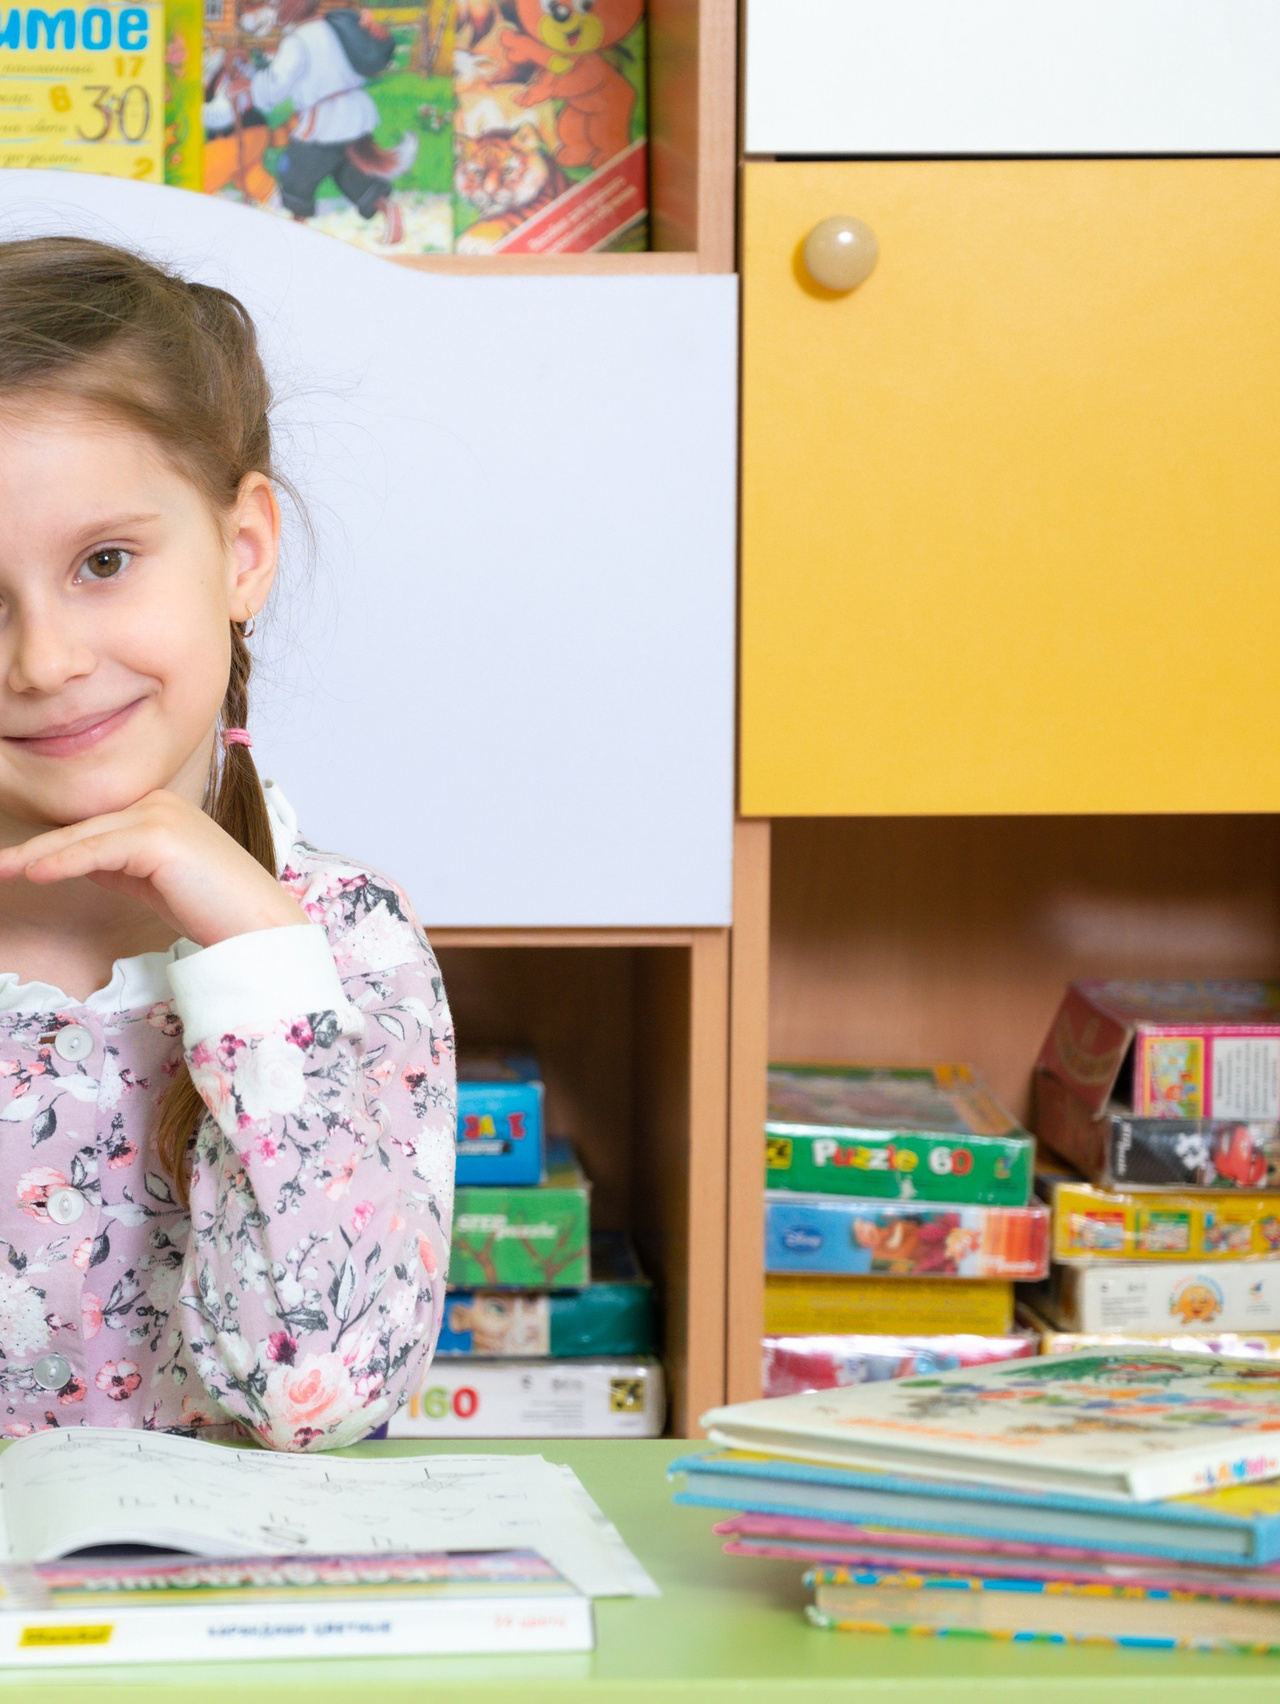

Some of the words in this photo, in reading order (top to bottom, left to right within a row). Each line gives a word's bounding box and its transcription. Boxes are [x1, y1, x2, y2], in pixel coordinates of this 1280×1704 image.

[113, 55, 144, 77] 17
[75, 85, 151, 143] 30
[812, 1138, 919, 1172] Puzzle
[928, 1146, 974, 1176] 60
